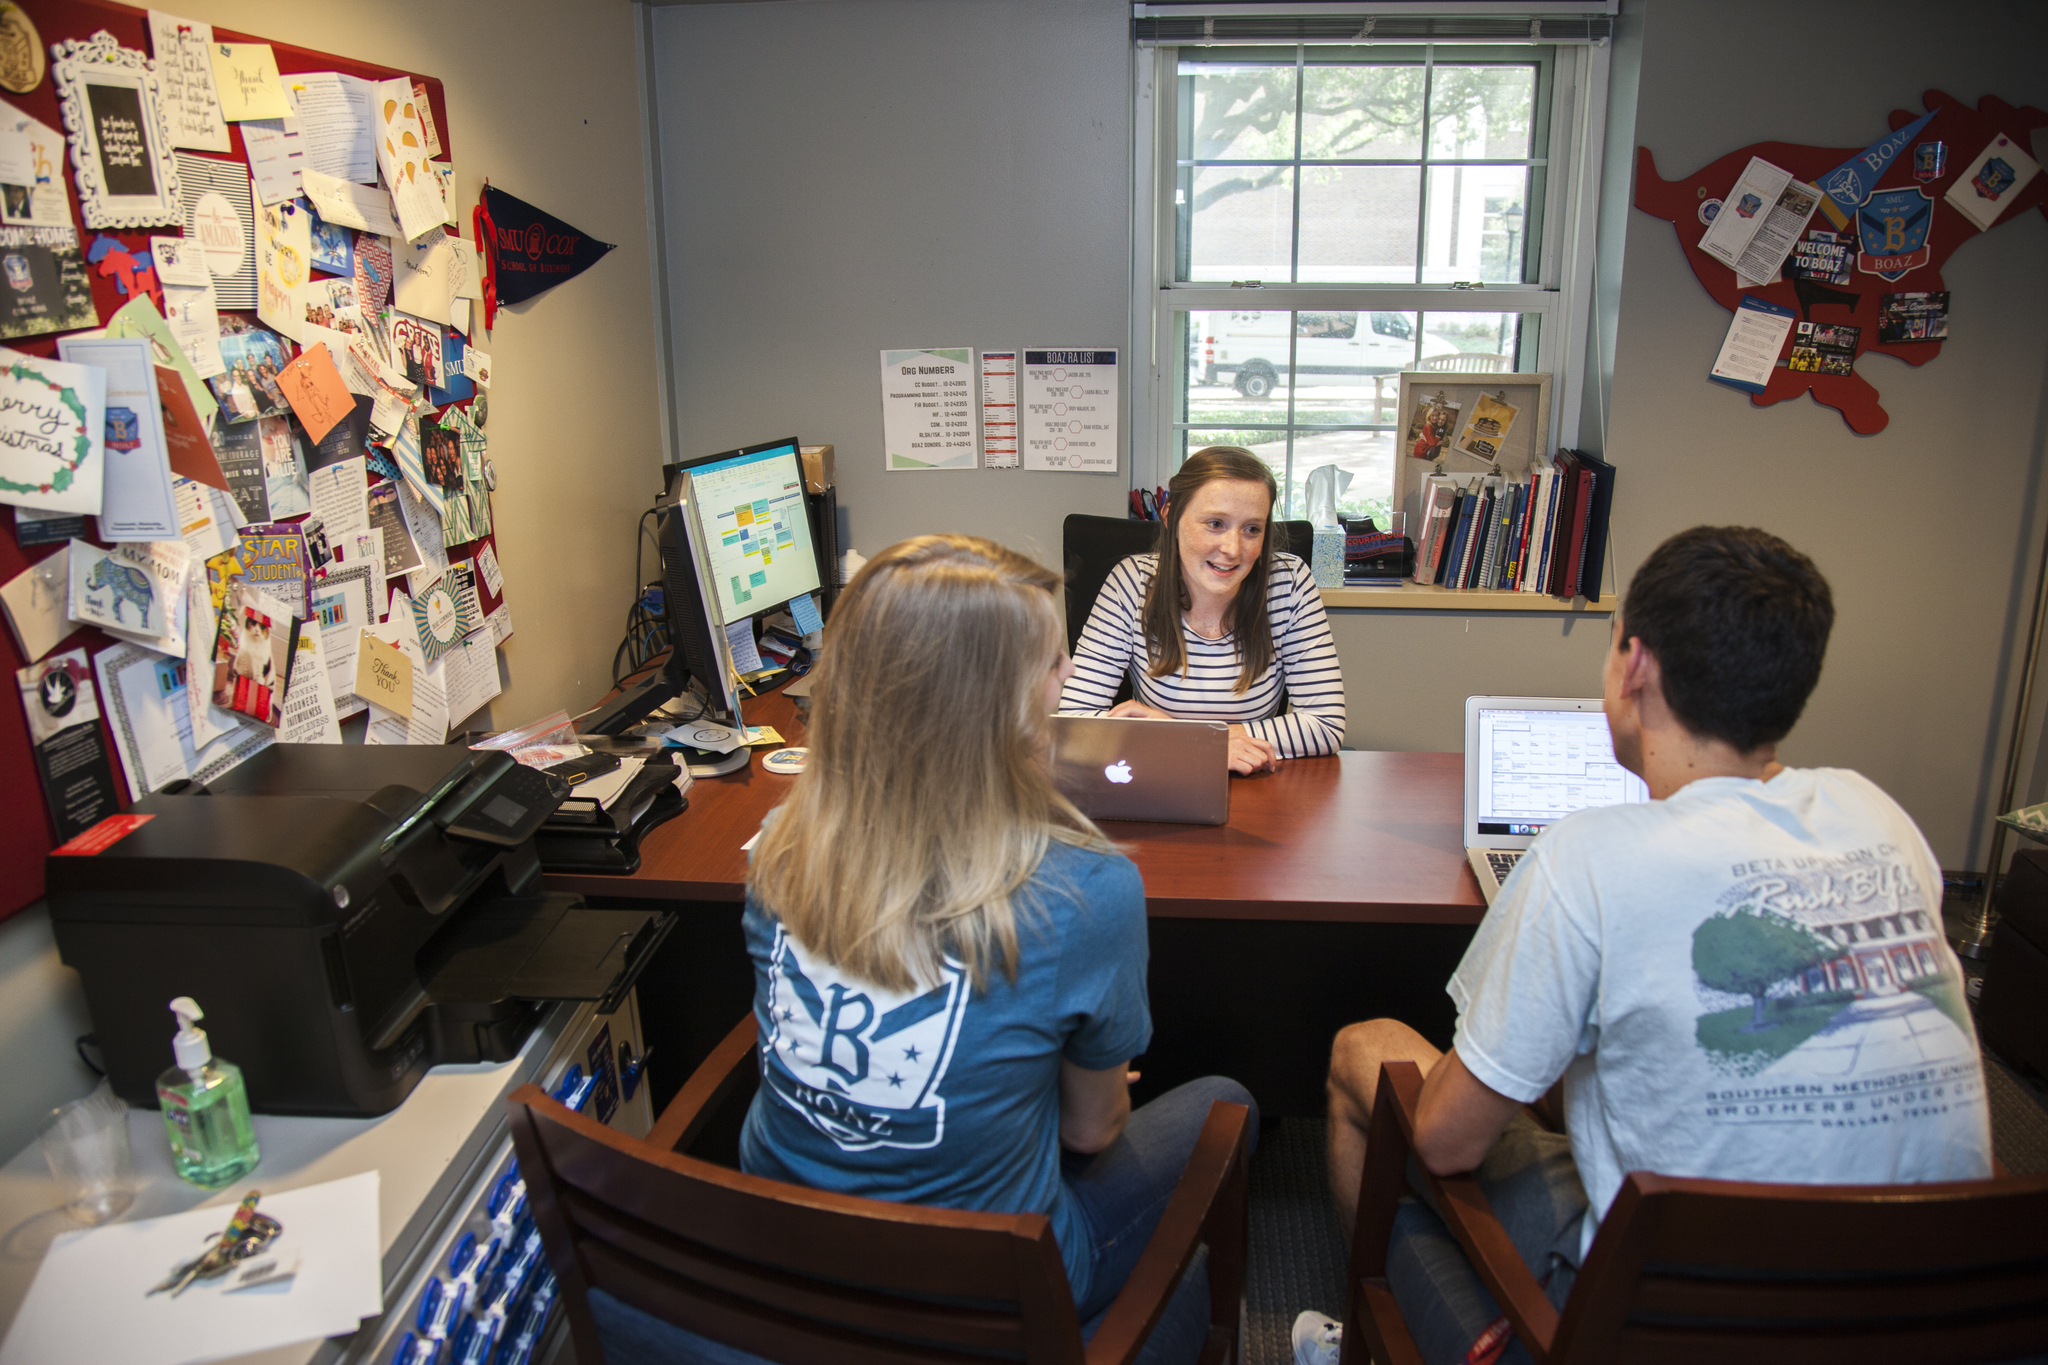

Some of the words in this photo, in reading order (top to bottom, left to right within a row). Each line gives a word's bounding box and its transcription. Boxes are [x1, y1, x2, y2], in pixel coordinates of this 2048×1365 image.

[1864, 130, 1911, 173] BOAZ
[1922, 154, 1935, 170] B
[1986, 170, 2001, 188] B
[1885, 195, 1905, 205] SMU
[1975, 182, 1994, 199] BOAZ
[200, 226, 242, 248] AMAZING
[498, 227, 524, 252] SMU
[546, 233, 581, 255] COX
[1881, 215, 1907, 252] B
[1797, 241, 1846, 258] WELCOME
[1795, 255, 1810, 268] TO
[1812, 258, 1842, 272] BOAZ
[1874, 255, 1913, 270] BOAZ
[1889, 302, 1909, 312] Boaz
[1909, 302, 1944, 311] Commons
[1047, 352, 1067, 364] BOAZ
[1068, 352, 1079, 364] RA
[1080, 352, 1095, 363] LIST
[445, 359, 465, 377] SMU
[0, 399, 69, 435] erry
[0, 426, 73, 463] istmas
[271, 433, 291, 449] YOU
[228, 449, 260, 460] COURAGE
[274, 448, 293, 463] ARE
[242, 468, 260, 476] YOU
[1437, 506, 1447, 535] Education
[1346, 531, 1404, 546] COURAGEOUS
[244, 538, 301, 569] STAR
[1428, 547, 1438, 568] Identity
[249, 563, 297, 582] STUDENT
[1509, 563, 1517, 578] USED
[372, 658, 400, 685] Thank
[376, 674, 395, 693] YOU
[285, 694, 318, 715] GOODNESS
[286, 705, 322, 728] FAITHFULNESS
[284, 715, 329, 741] GENTLENESS
[1732, 858, 1786, 878] BETA
[1723, 875, 1845, 918] Rush
[811, 982, 875, 1087] B
[1706, 1083, 1824, 1101] SOUTHERN
[1833, 1067, 1937, 1093] METHODIST
[1705, 1101, 1857, 1117] BROTHERS
[1871, 1087, 1945, 1110] UNDER
